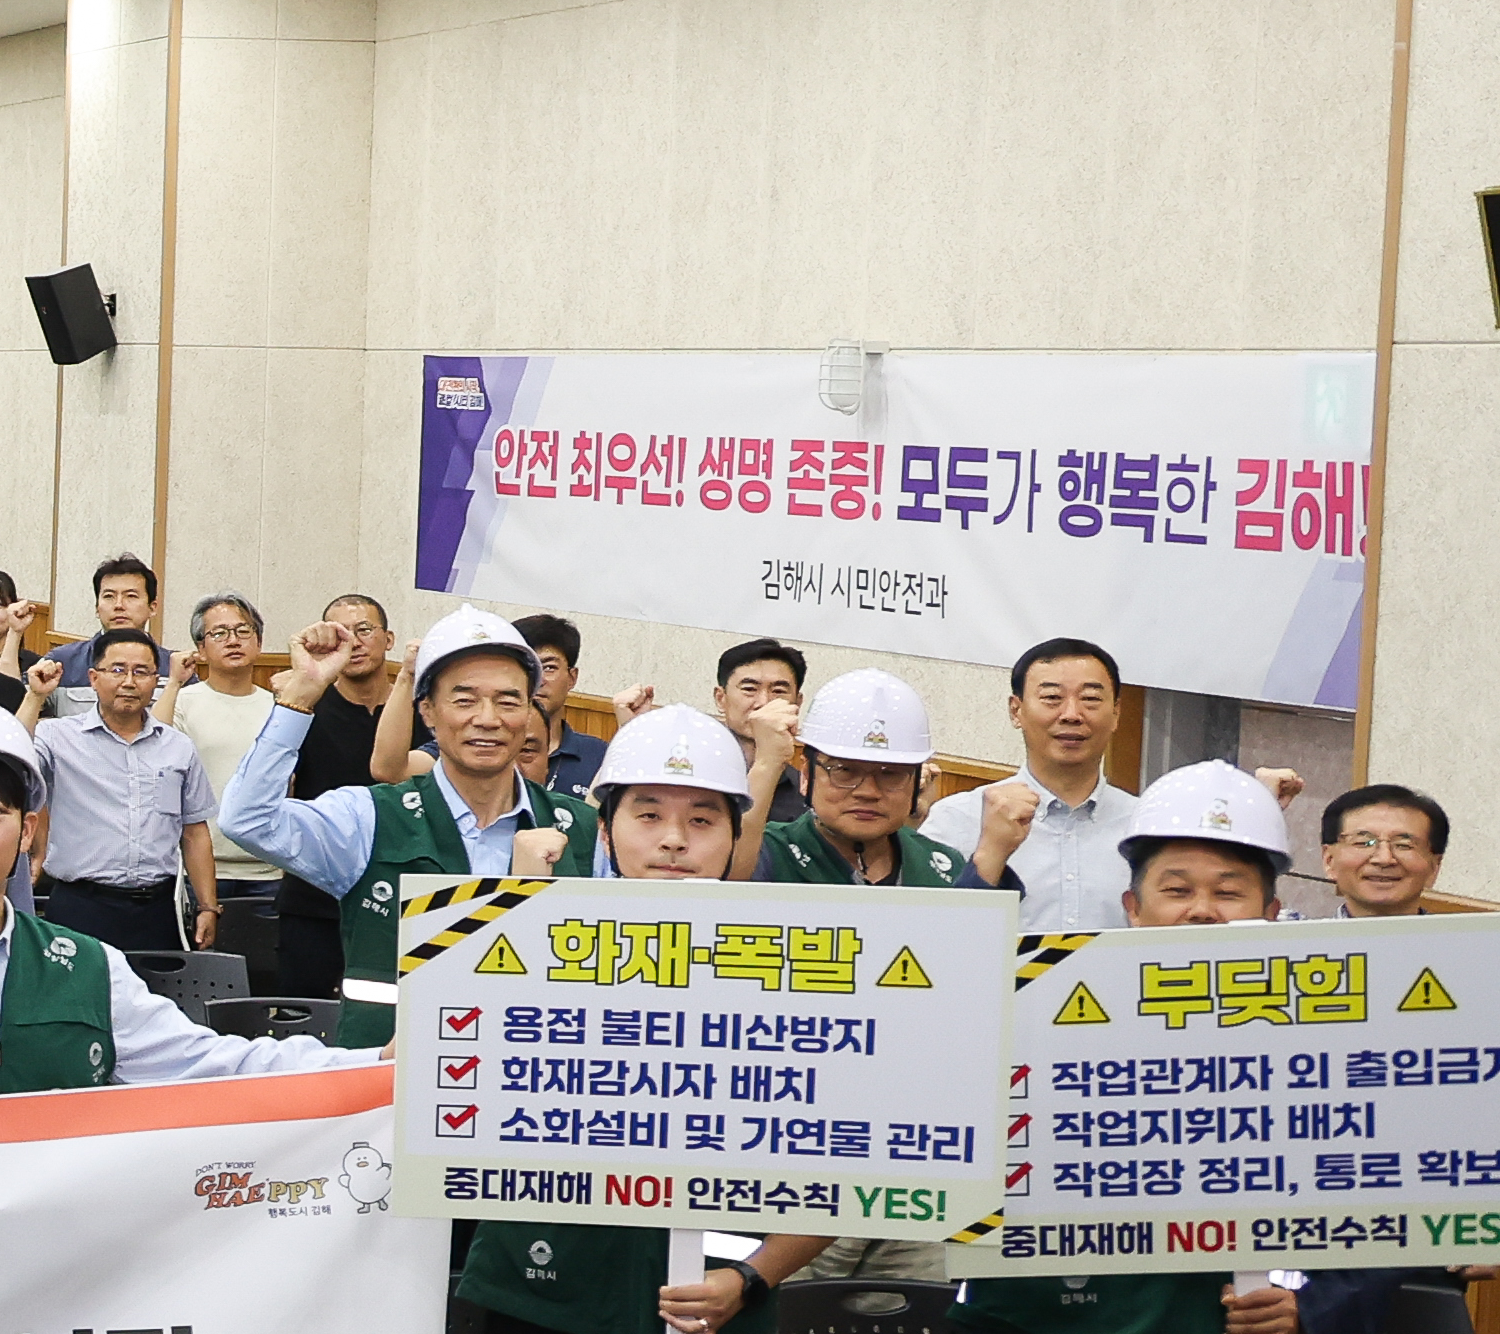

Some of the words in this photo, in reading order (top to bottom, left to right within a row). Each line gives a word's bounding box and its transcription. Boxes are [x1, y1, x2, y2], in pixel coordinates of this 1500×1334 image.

[492, 428, 560, 499] 안전
[569, 430, 688, 508] 최우선!
[698, 436, 773, 515] 생명
[786, 439, 885, 522] 존중!
[897, 444, 1042, 534] 모두가
[1058, 448, 1218, 546] 행복한
[1234, 457, 1369, 558] 김해!
[760, 559, 824, 605] 김해시
[831, 563, 948, 619] 시민안전과
[547, 918, 862, 995] 화재·폭발
[1137, 952, 1368, 1029] 부딪힘
[501, 1005, 587, 1045] 용접
[601, 1008, 686, 1049] 불티
[700, 1011, 877, 1057] 비산방지
[500, 1055, 717, 1103] 화재감시자
[730, 1063, 816, 1105] 배치
[1051, 1053, 1273, 1098] 작업관계자
[1286, 1051, 1329, 1090] 외
[499, 1106, 671, 1150] 소화설비
[684, 1113, 726, 1153] 및
[741, 1115, 873, 1162] 가연물
[886, 1121, 974, 1165] 관리
[1052, 1104, 1274, 1147] 작업지휘자
[1287, 1101, 1376, 1140] 배치
[194, 1171, 253, 1197] GIM
[225, 1160, 257, 1169] WORRY
[1052, 1161, 1185, 1197] 작업장
[1198, 1155, 1299, 1197] 정리,
[1313, 1151, 1403, 1191] 통로
[1417, 1148, 1500, 1188] 확보
[267, 1205, 309, 1219] 행복도시
[311, 1204, 332, 1216] 김해
[443, 1167, 594, 1208] 중대재해
[604, 1174, 673, 1210] NO!
[686, 1176, 841, 1218] 안전수칙
[853, 1185, 947, 1222] YES!
[1000, 1221, 1154, 1259] 중대재해
[1167, 1219, 1237, 1254] NO!
[1251, 1213, 1408, 1251] 안전수칙
[525, 1267, 557, 1281] 김해시
